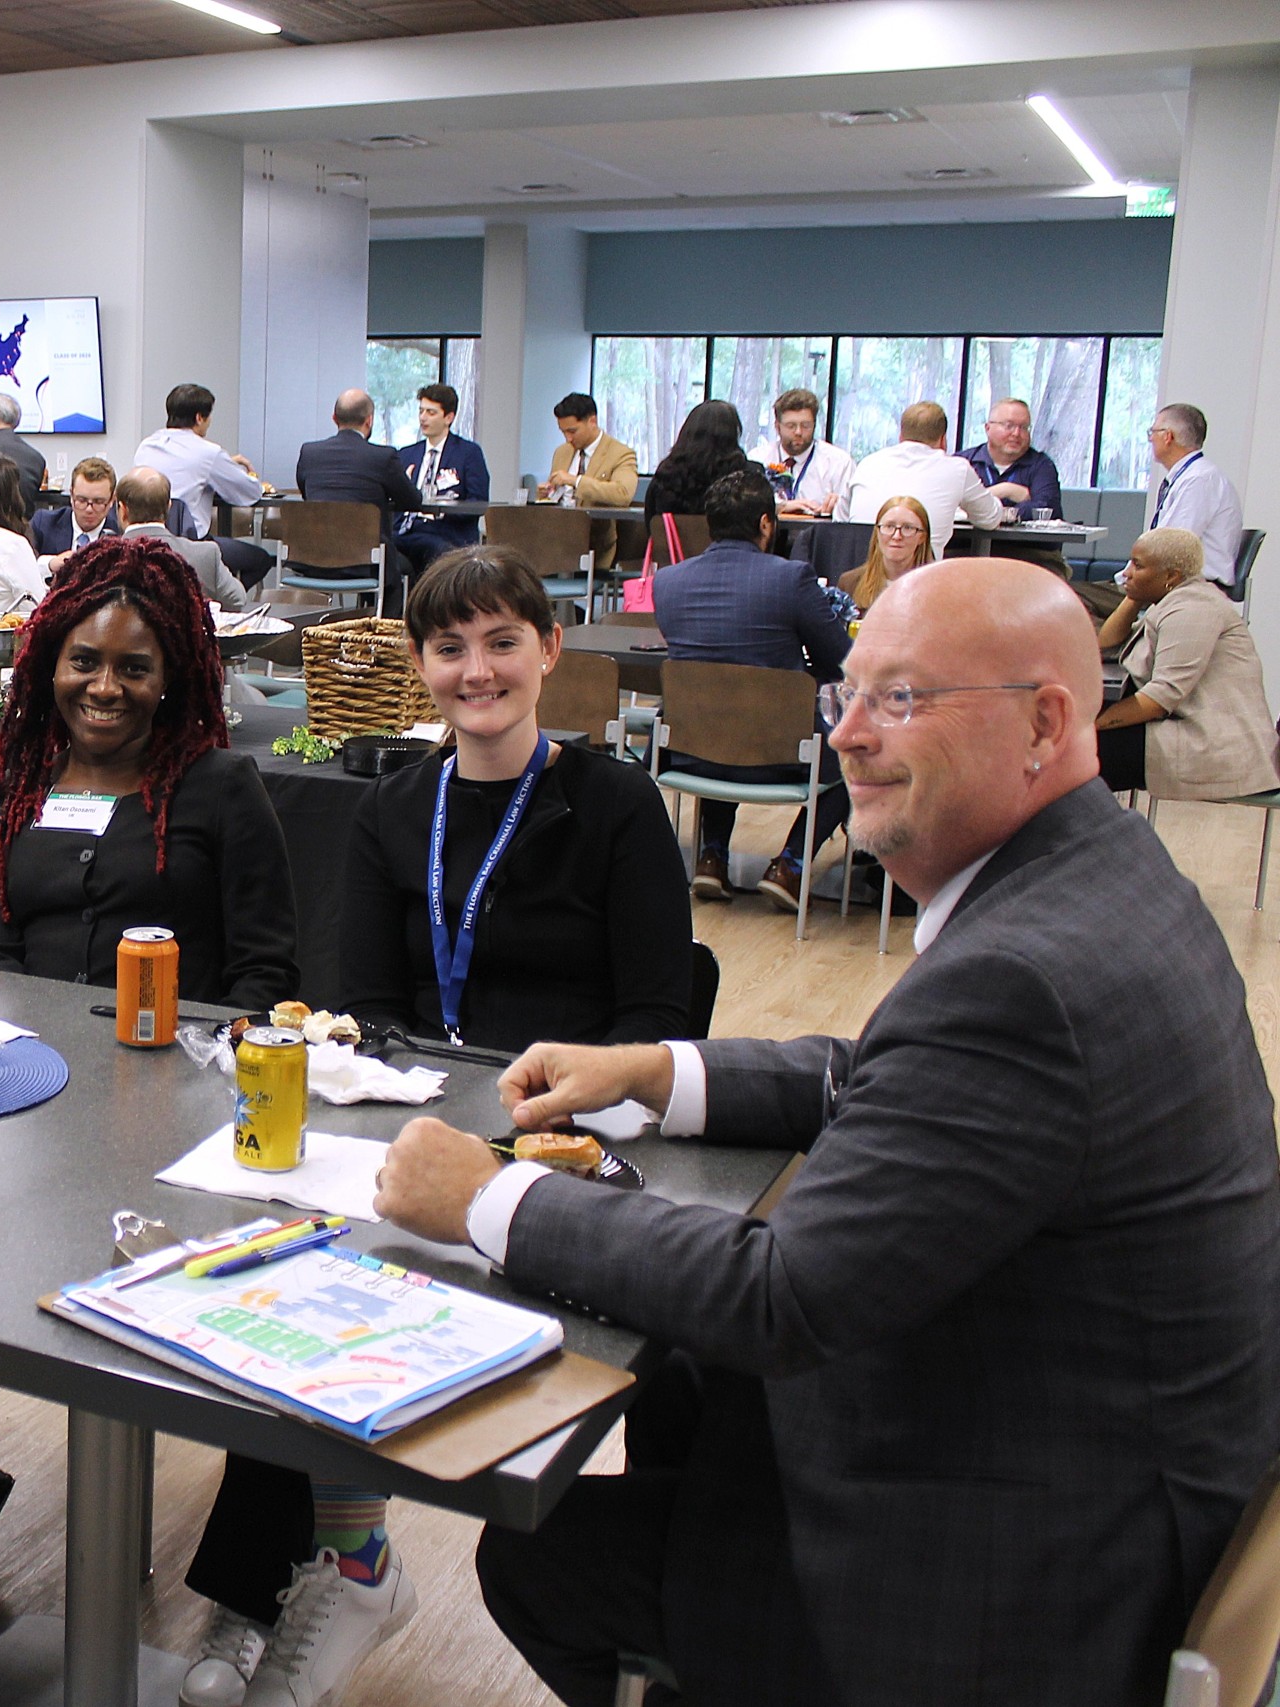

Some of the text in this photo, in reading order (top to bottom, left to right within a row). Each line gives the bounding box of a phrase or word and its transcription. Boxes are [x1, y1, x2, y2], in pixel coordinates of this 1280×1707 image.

[438, 780, 447, 813] FLORIDA
[436, 814, 444, 830] BAR
[433, 831, 442, 870] CRIMINAL
[463, 772, 535, 930] THE FLORIDA BAR CRIMINAL LAW SECTION
[432, 871, 440, 888] LAW
[432, 889, 442, 925] SECTION
